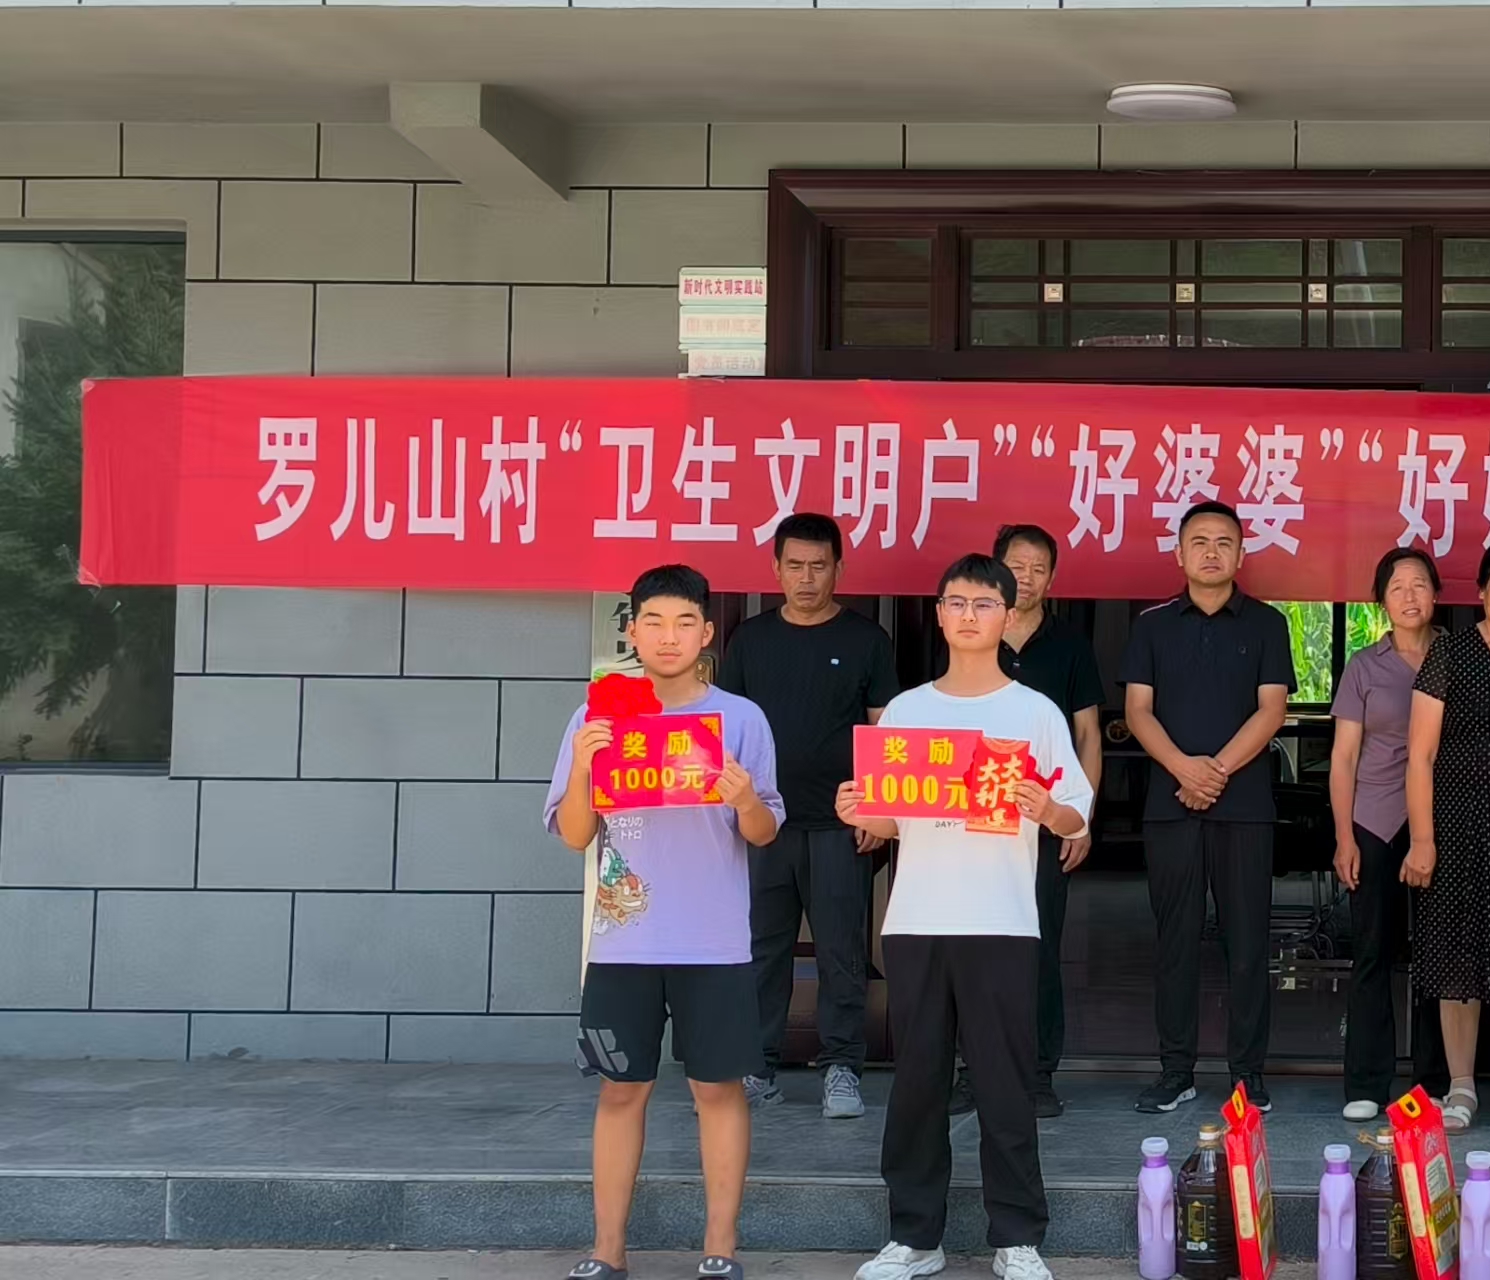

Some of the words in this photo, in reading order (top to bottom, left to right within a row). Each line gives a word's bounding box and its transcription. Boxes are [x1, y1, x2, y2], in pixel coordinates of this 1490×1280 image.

[684, 278, 763, 295] 新时代文明实践站
[622, 731, 692, 759] 奖励
[883, 736, 954, 765] 奖励
[610, 764, 705, 790] 1000元
[862, 773, 969, 810] 1000元
